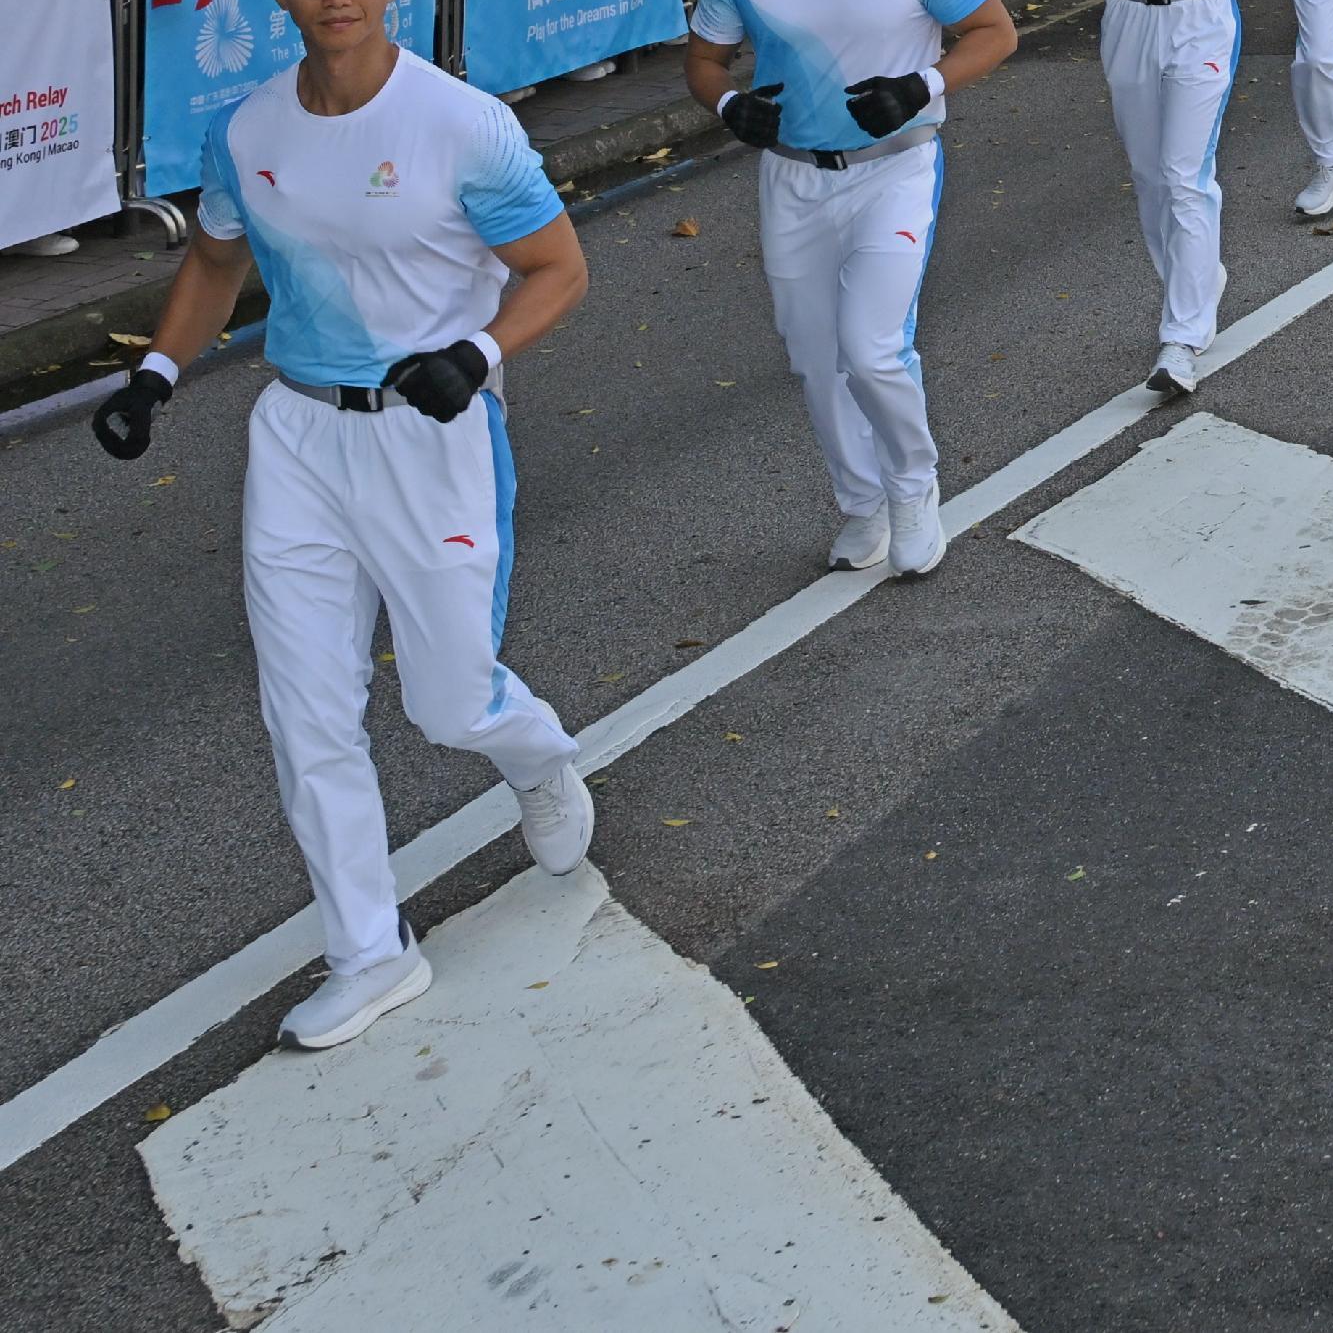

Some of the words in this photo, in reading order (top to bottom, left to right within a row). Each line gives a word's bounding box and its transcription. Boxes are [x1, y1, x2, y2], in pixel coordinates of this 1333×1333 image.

[546, 19, 559, 35] for
[560, 12, 575, 31] the
[576, 4, 617, 27] Dreams
[271, 47, 289, 62] The
[26, 86, 68, 111] Relay
[40, 113, 79, 142] 2025
[16, 145, 41, 165] Kong
[48, 139, 80, 156] Macao
